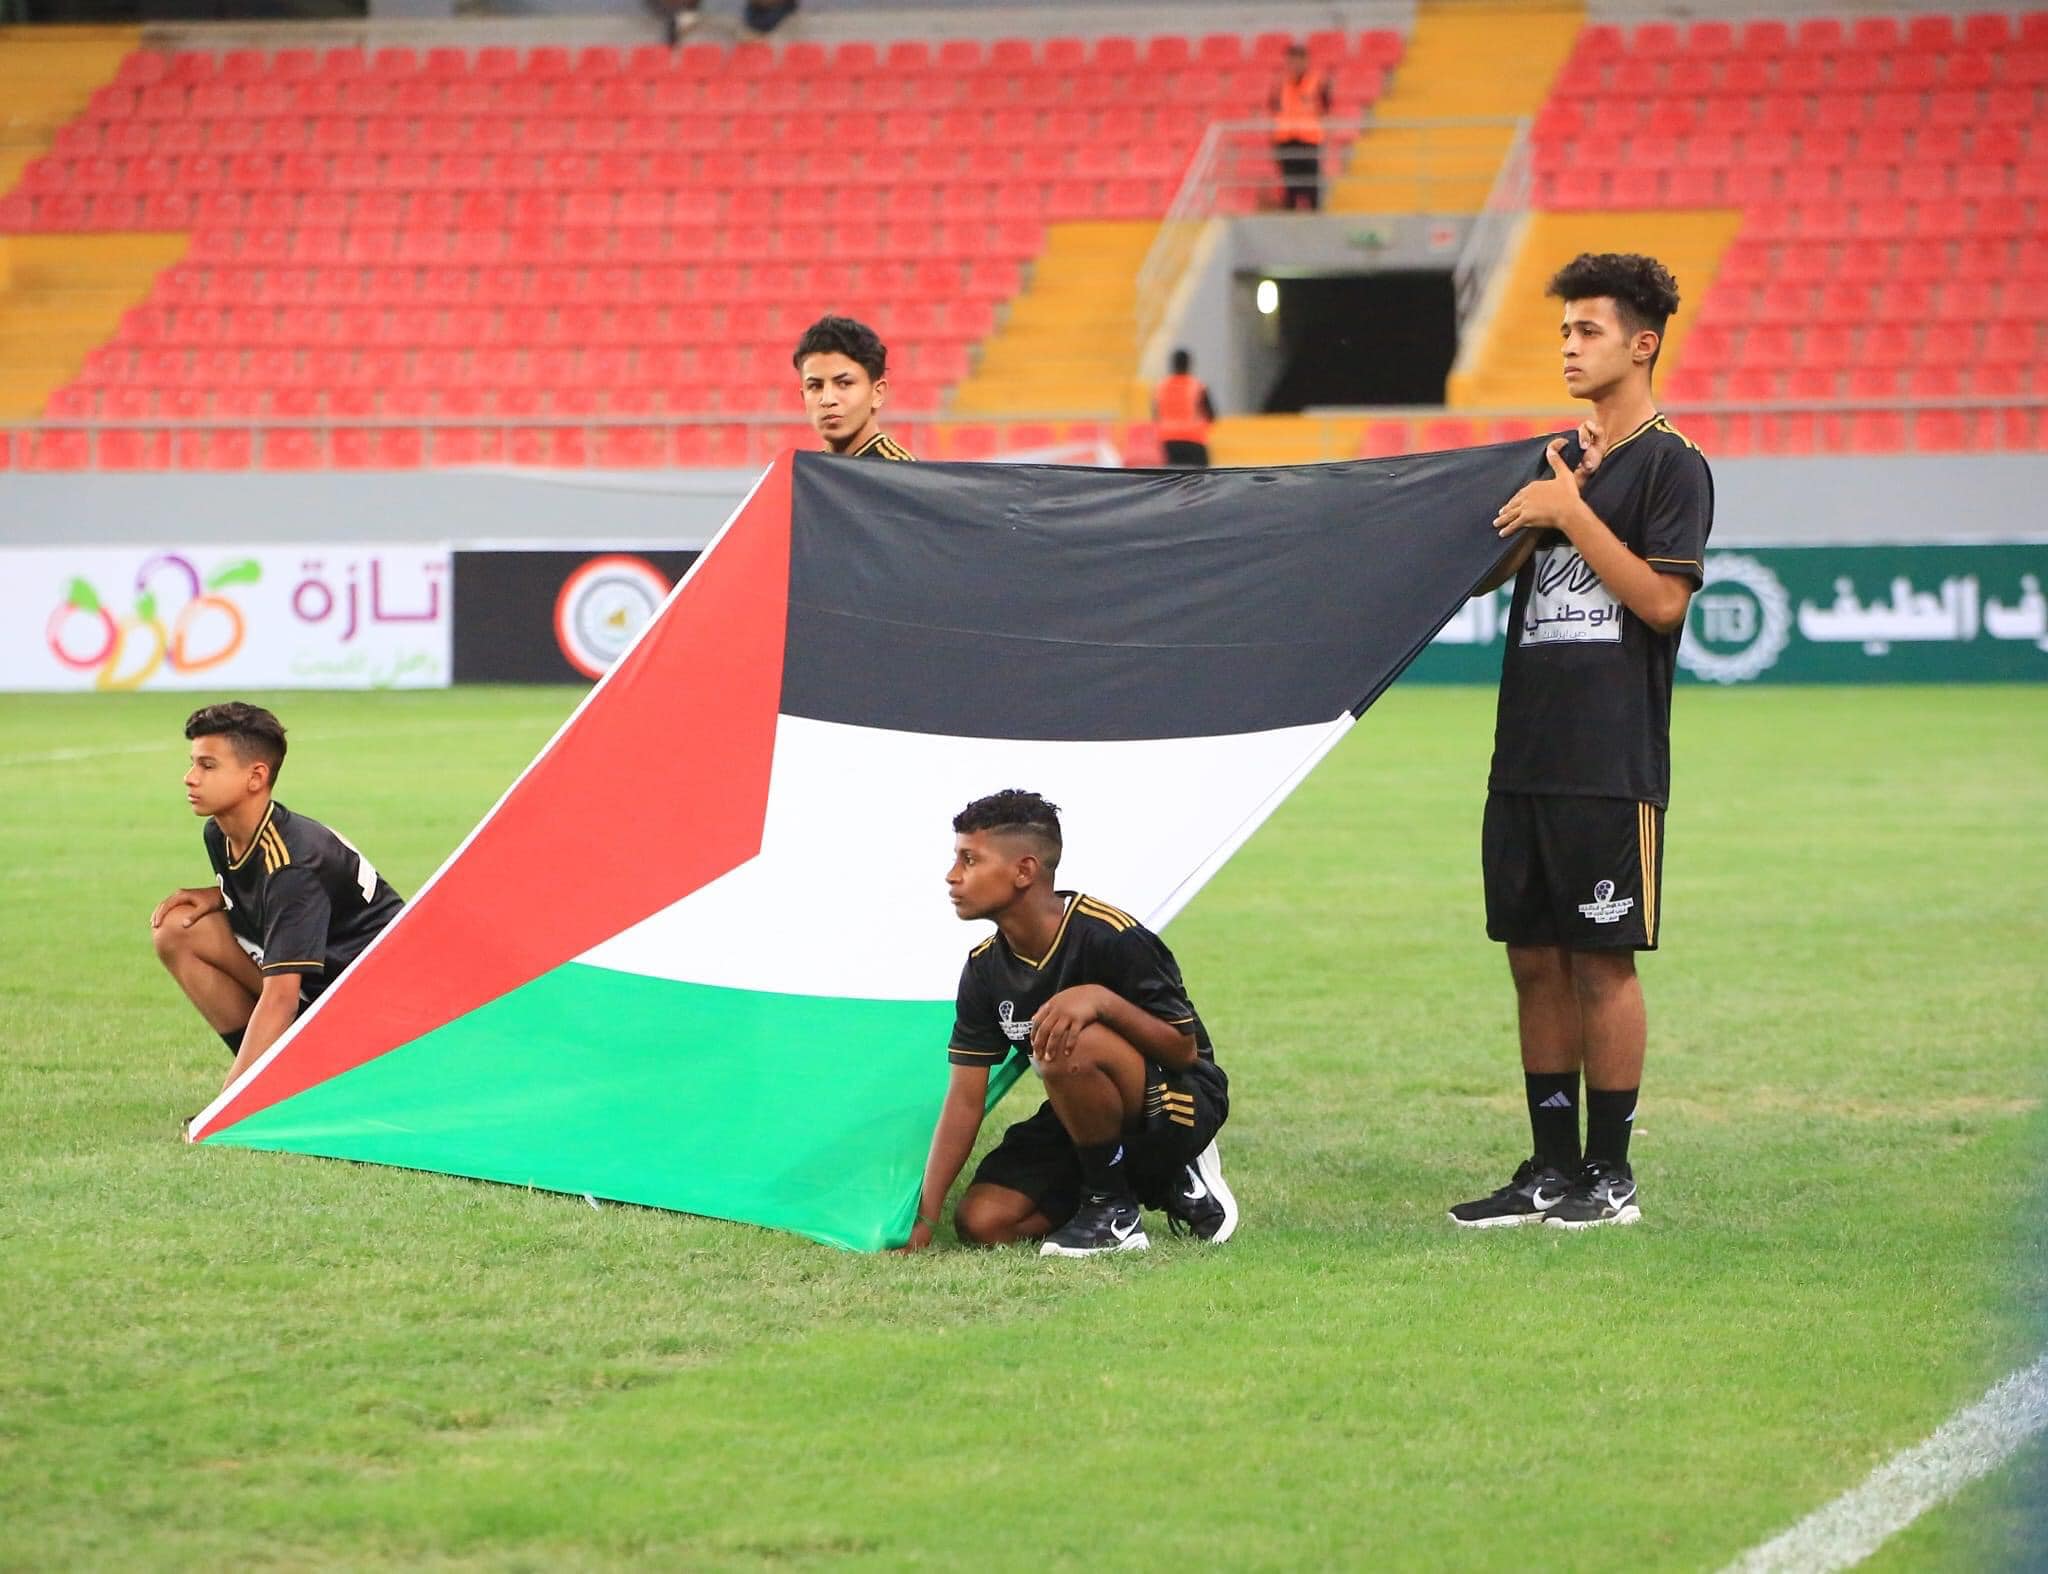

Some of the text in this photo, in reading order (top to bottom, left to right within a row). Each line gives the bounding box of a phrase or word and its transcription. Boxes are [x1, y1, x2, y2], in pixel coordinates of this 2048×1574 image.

[292, 560, 447, 642] تازة
[1524, 603, 1621, 637] الوطني
[1798, 575, 1980, 656] الطيف
